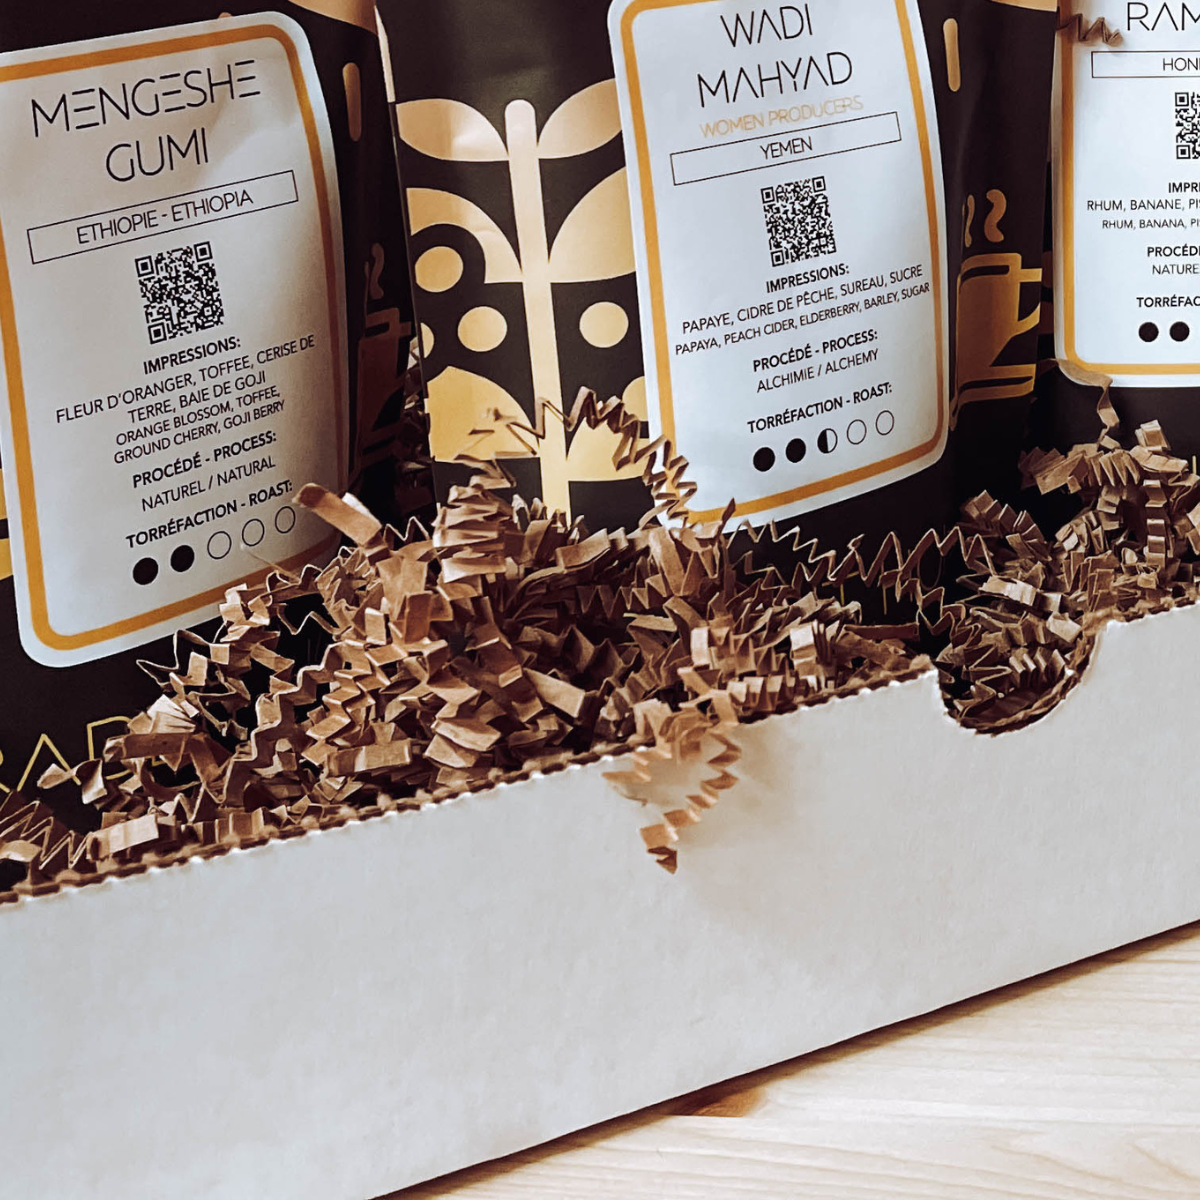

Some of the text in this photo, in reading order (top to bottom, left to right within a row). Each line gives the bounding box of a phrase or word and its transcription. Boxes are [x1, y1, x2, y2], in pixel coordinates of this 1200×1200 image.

[720, 3, 813, 48] WADI
[31, 59, 261, 138] MENGESHE
[697, 51, 852, 108] MAHYAD
[700, 95, 863, 138] WOMEN PRODUCERS
[106, 127, 208, 182] GUMI
[760, 136, 813, 160] YEMEN
[76, 210, 159, 244] ETHIOPIE
[171, 189, 254, 222] ETHIOPIA
[1087, 199, 1126, 212] RHUM,
[1130, 198, 1185, 211] BANANE,
[1102, 219, 1136, 230] RHUM,
[1139, 218, 1187, 229] BANANA,
[683, 264, 923, 334] PAPAYE, CIDRE DE PÊCHE, SUREAU, SUCRE
[766, 263, 849, 293] IMPRESSIONS:
[675, 282, 930, 355] PAPAYA, PEACH CIDER, ELDERBERRY, BARLEY, SUGAR
[143, 336, 241, 375] IMPRESSIONS:
[753, 343, 812, 372] PROCÉDÉ
[822, 329, 878, 354] PROCESS:
[757, 366, 815, 393] ALCHIMIE
[825, 348, 878, 374] ALCHEMY
[56, 335, 315, 423] FLEUR D'ORANGER, TOFFEE, CERISE DE
[127, 370, 266, 423] TERRE, BAIE DE GOJI
[114, 399, 285, 464] GROUND CHERRY, GOJI BERRY
[116, 385, 280, 446] ORANGE BLOSSOM, TOFFEE,
[747, 396, 843, 433] TORRÉFACTION
[853, 382, 892, 404] ROAST:
[132, 451, 202, 489] PROCÉDÉ
[213, 430, 277, 462] PROCESS:
[141, 480, 206, 512] NATUREL
[217, 455, 276, 486] NATURAL
[125, 499, 237, 548] TORRÉFACTION
[249, 479, 292, 507] ROAST:
